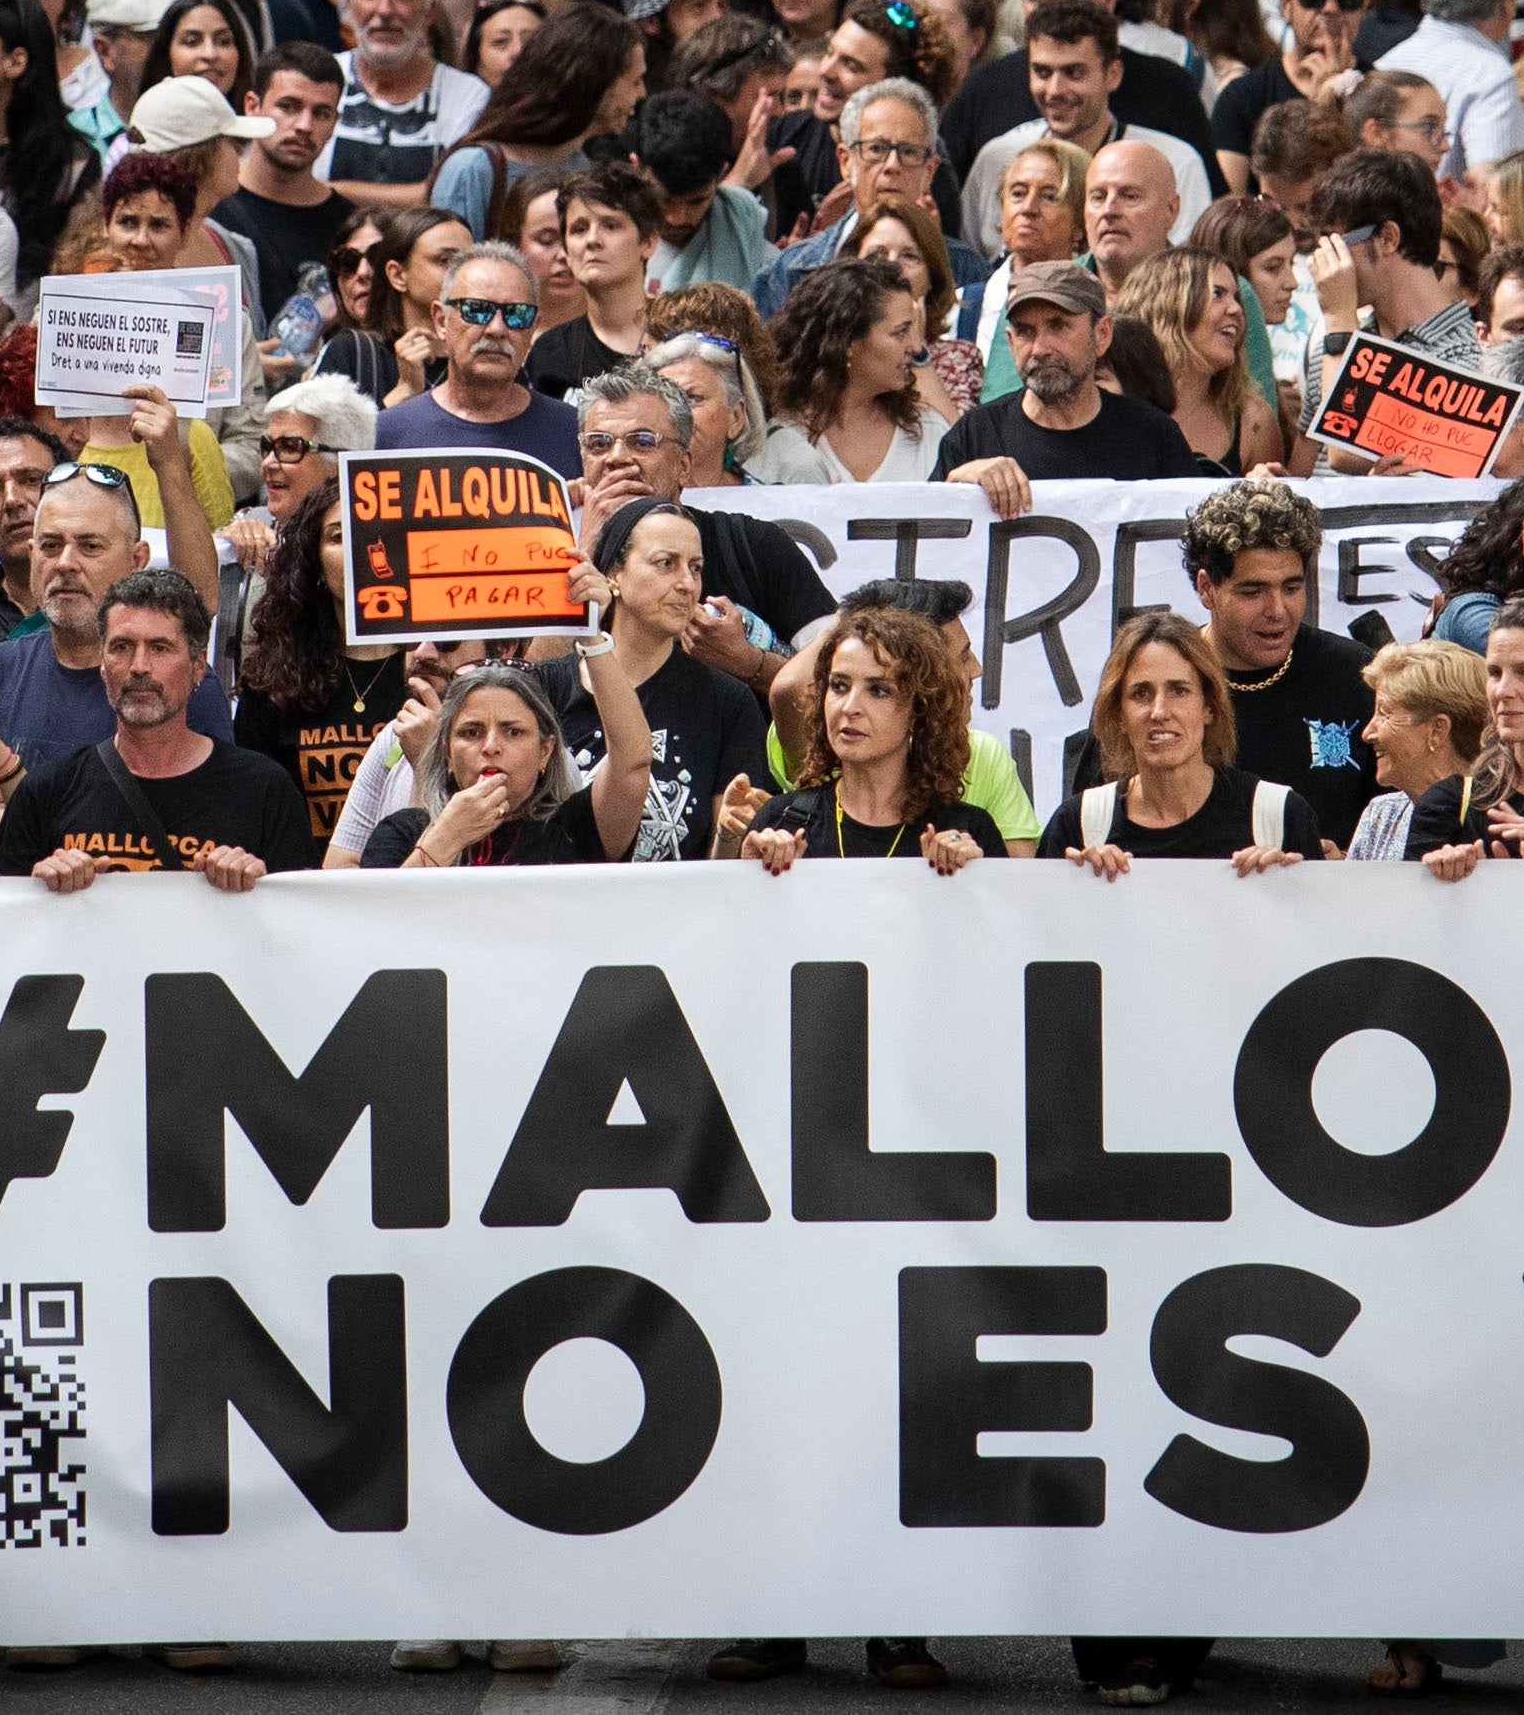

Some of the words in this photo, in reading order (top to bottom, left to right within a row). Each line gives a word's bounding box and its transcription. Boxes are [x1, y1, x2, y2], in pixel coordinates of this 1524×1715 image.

[47, 309, 57, 325] SI
[58, 310, 77, 327] ENS
[78, 312, 116, 330] NEGUEN
[119, 316, 129, 331] EL
[131, 316, 171, 338] SOSTRE,
[56, 332, 75, 349] ENS
[76, 333, 115, 352] NEGUEN
[117, 336, 127, 353] EL
[129, 338, 159, 356] FUTUR
[51, 352, 72, 370] Dret
[76, 359, 81, 370] a
[84, 360, 99, 371] una
[138, 361, 161, 380] digna
[1349, 347, 1393, 386] SE
[1387, 362, 1508, 427] ALQUILA
[1366, 425, 1433, 464] LLOGAR
[1391, 408, 1417, 430] NO
[1422, 420, 1441, 436] HO
[1446, 427, 1474, 447] PUC
[353, 470, 403, 522] SE
[412, 466, 570, 526] ALQUILA
[462, 544, 499, 566] NO
[1338, 535, 1449, 607] ES
[445, 585, 545, 608] PAGAR
[148, 1264, 723, 1536] NO
[898, 1262, 1371, 1534] ES
